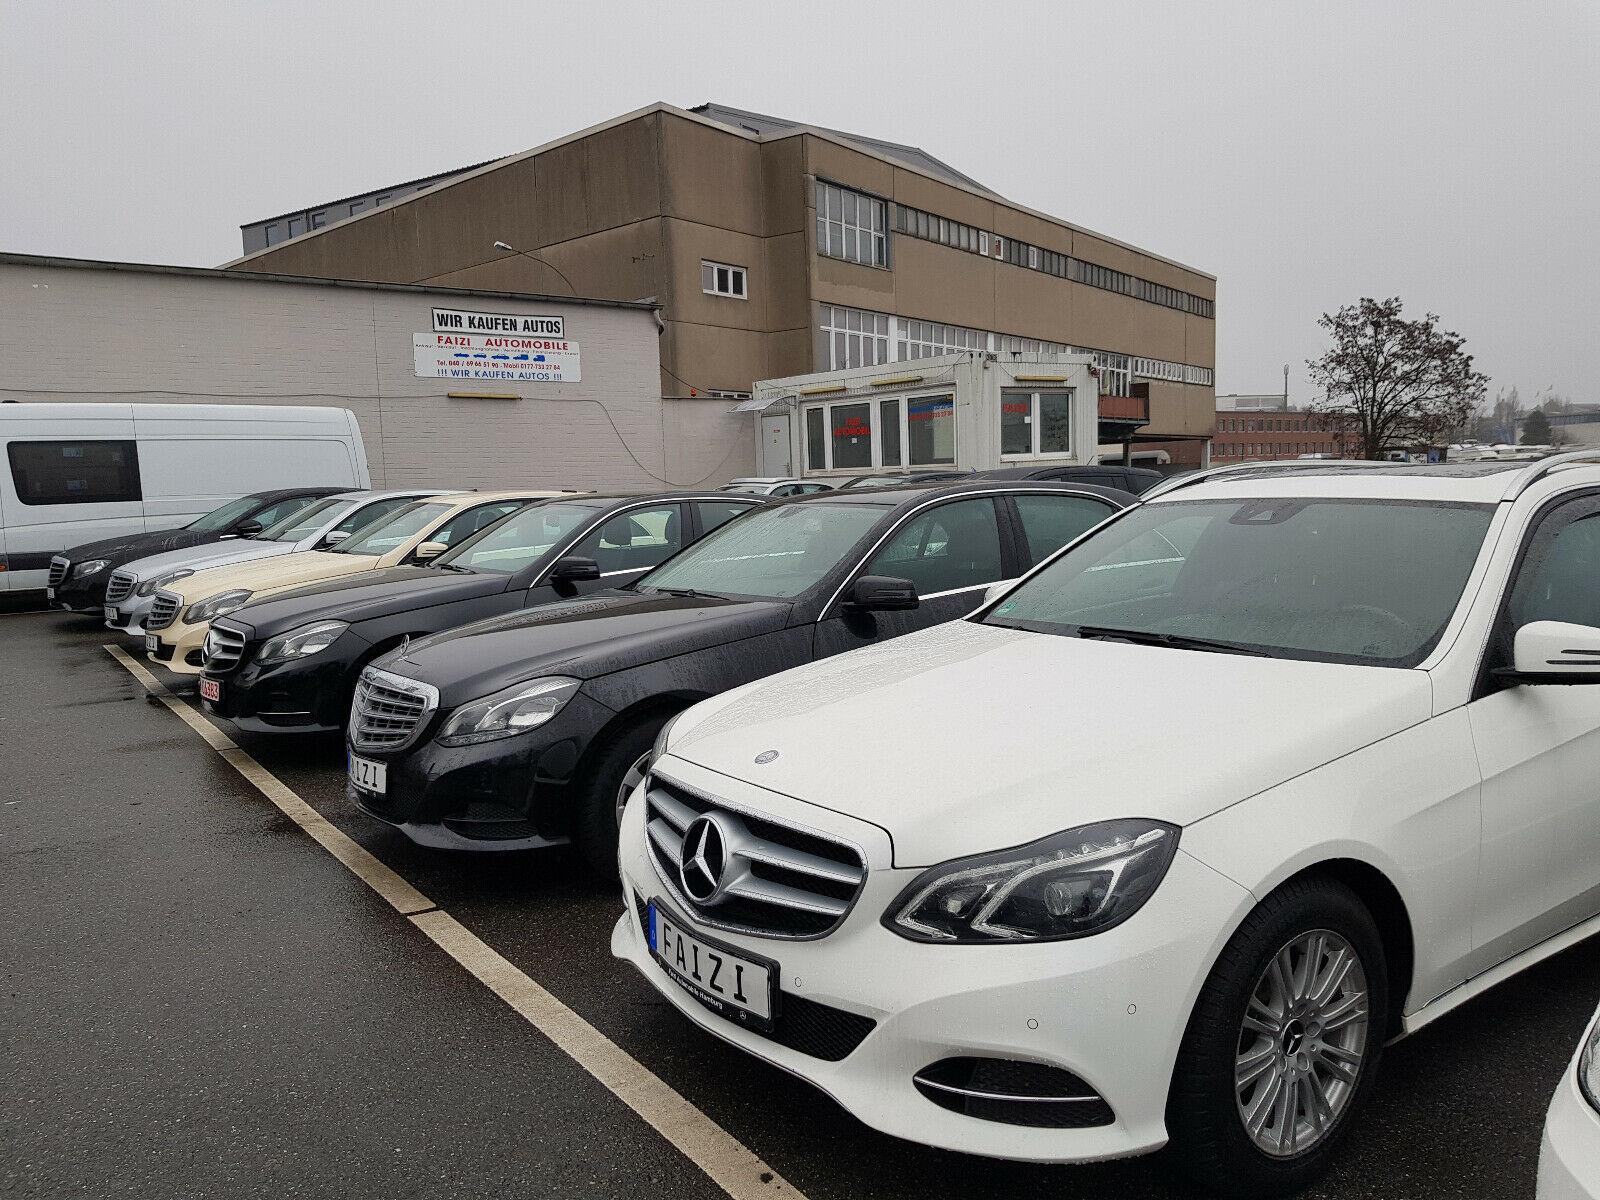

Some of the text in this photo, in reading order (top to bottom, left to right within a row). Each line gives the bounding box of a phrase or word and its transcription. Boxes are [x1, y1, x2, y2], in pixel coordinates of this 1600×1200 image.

[436, 313, 561, 334] WIR KAUFEN AUTOS
[437, 335, 568, 351] FAIZI AUTOMOBILE
[450, 369, 470, 377] WIR
[474, 370, 514, 379] KAUFEN
[518, 371, 550, 381] AUTOS
[663, 922, 748, 1005] FAIZI
